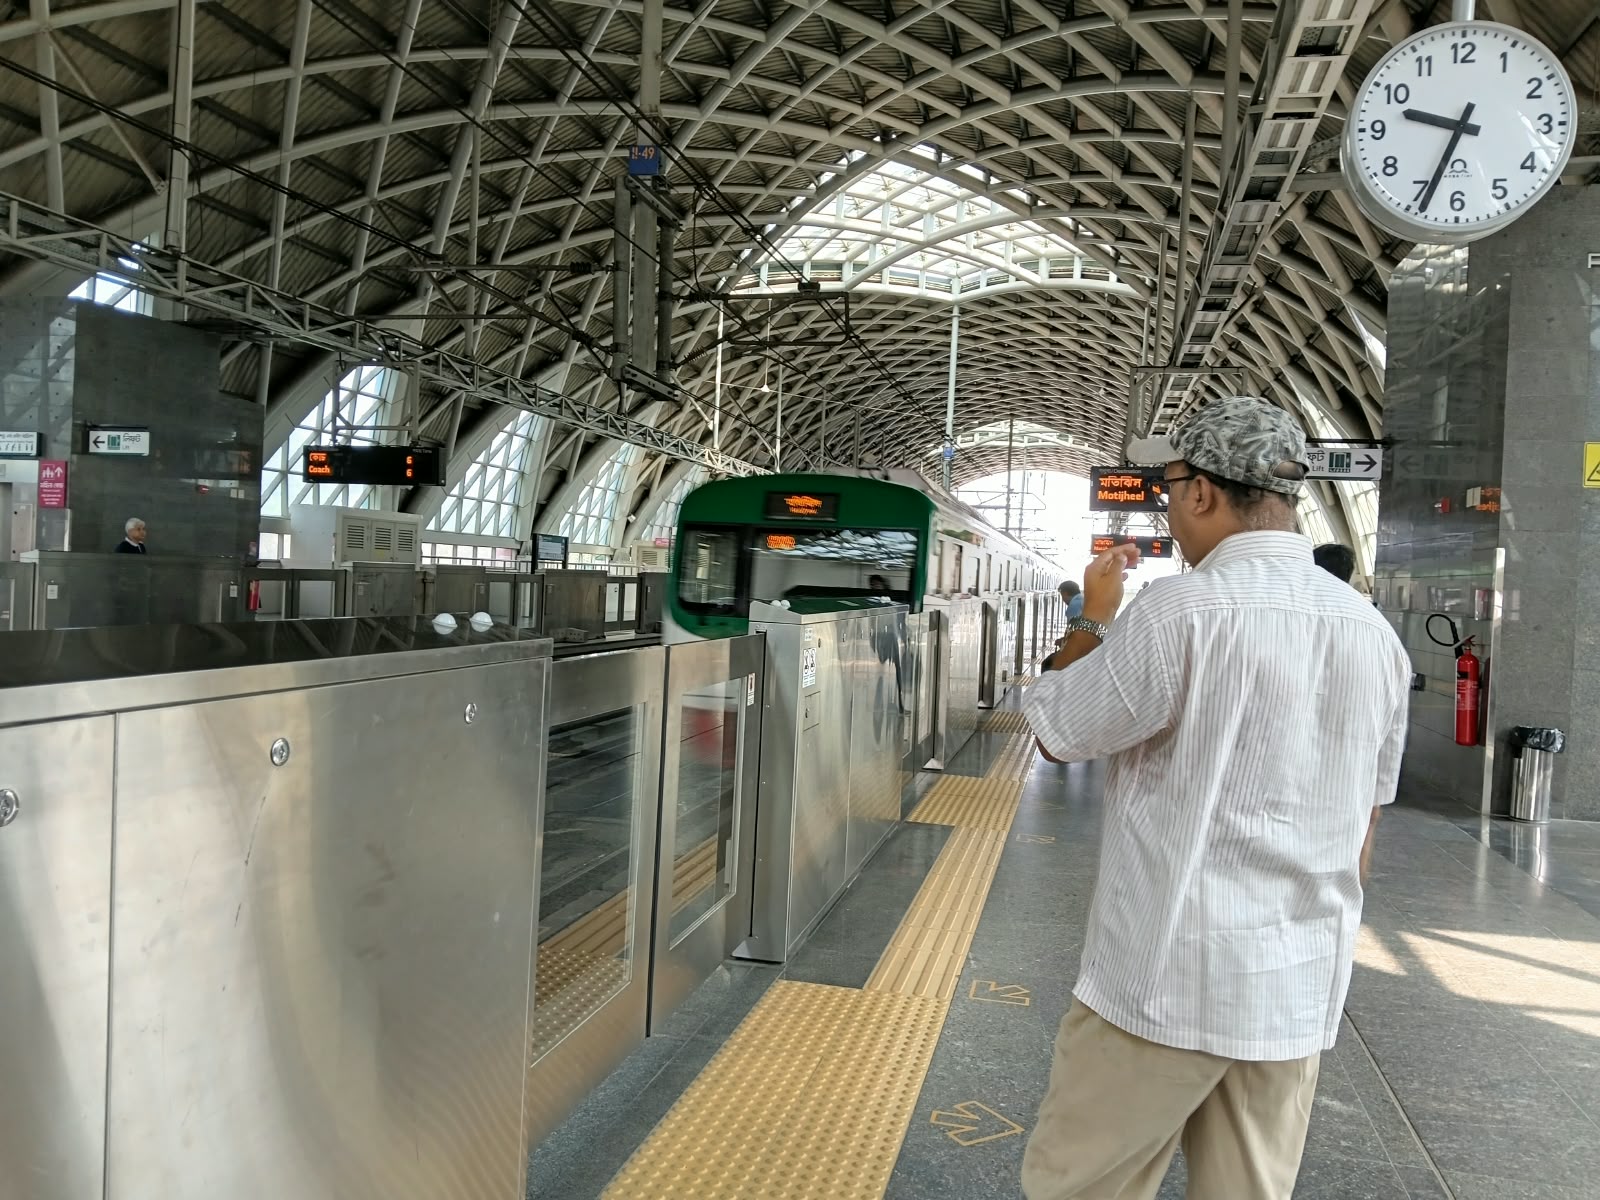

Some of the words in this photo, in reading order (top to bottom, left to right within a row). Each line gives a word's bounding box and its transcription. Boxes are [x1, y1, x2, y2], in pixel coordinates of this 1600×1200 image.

[1450, 41, 1476, 64] 12
[1499, 51, 1508, 74] 1
[1415, 55, 1433, 77] 11
[1384, 83, 1410, 105] 10
[1526, 77, 1543, 99] 2
[1370, 119, 1386, 141] 9
[1536, 113, 1553, 135] 3
[1381, 155, 1398, 177] 8
[1520, 151, 1537, 173] 4
[1412, 180, 1429, 202] 7
[1491, 178, 1508, 200] 5
[1449, 190, 1466, 212] 6
[308, 465, 330, 473] Coach
[406, 468, 412, 477] 6
[1099, 475, 1142, 488] মতিঝিল
[1098, 490, 1144, 502] Motijheel
